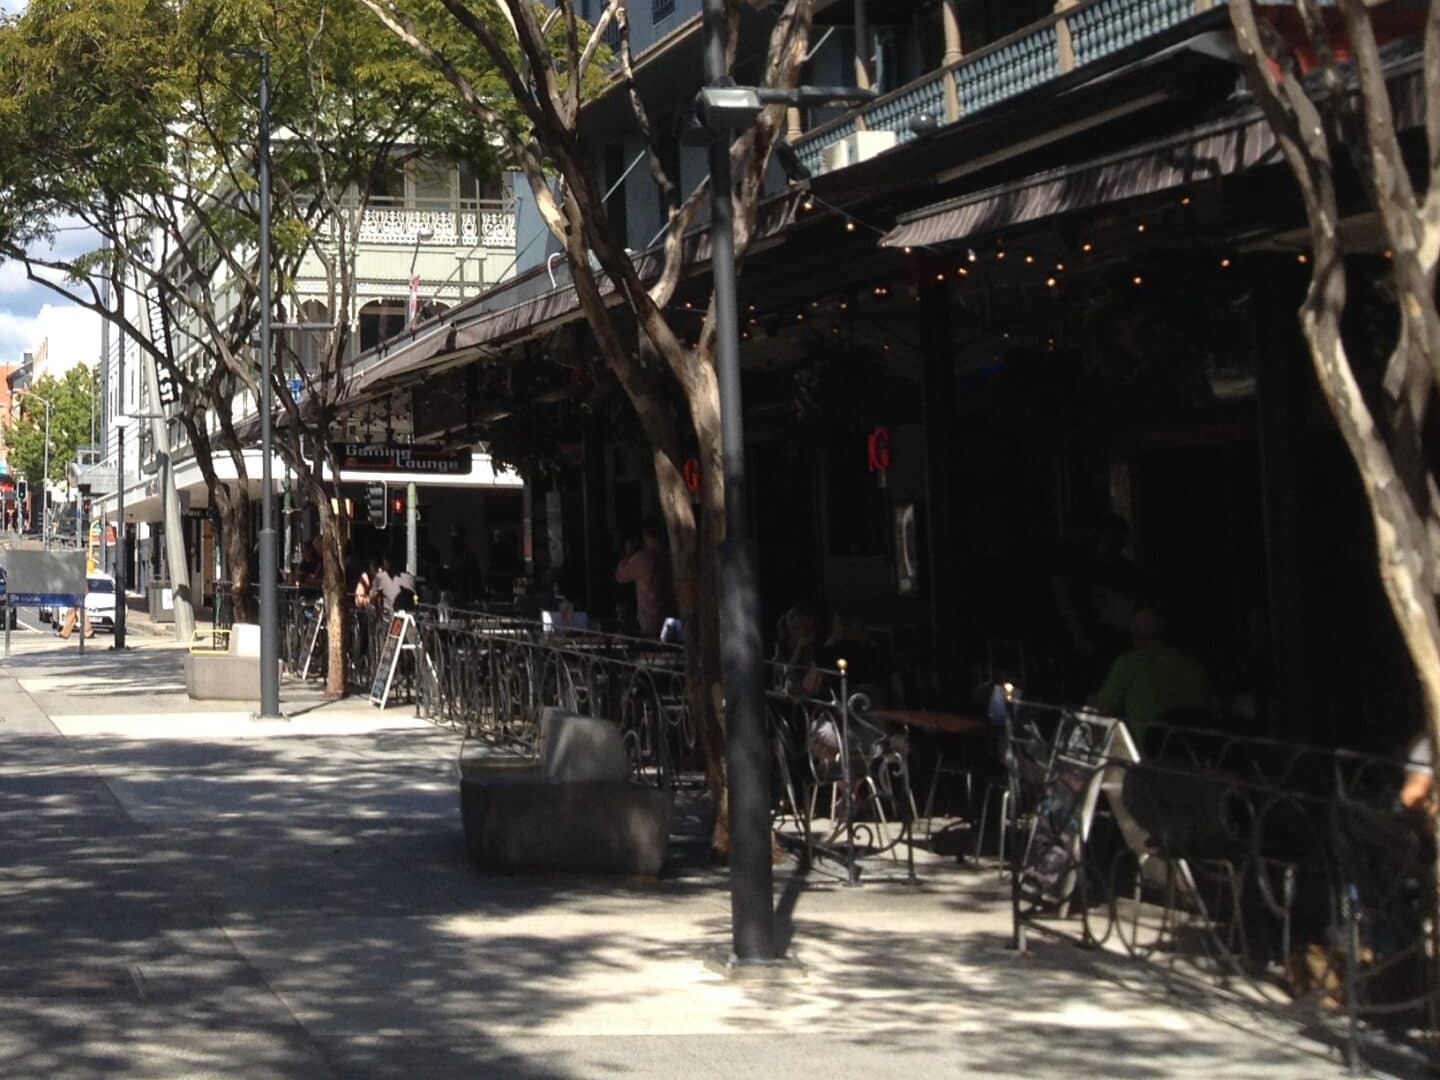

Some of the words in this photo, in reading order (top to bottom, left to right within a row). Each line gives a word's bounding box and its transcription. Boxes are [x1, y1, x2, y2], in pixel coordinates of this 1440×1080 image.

[146, 286, 171, 381] BRUNSWK
[345, 443, 412, 460] Gaming
[395, 455, 458, 472] Lounge
